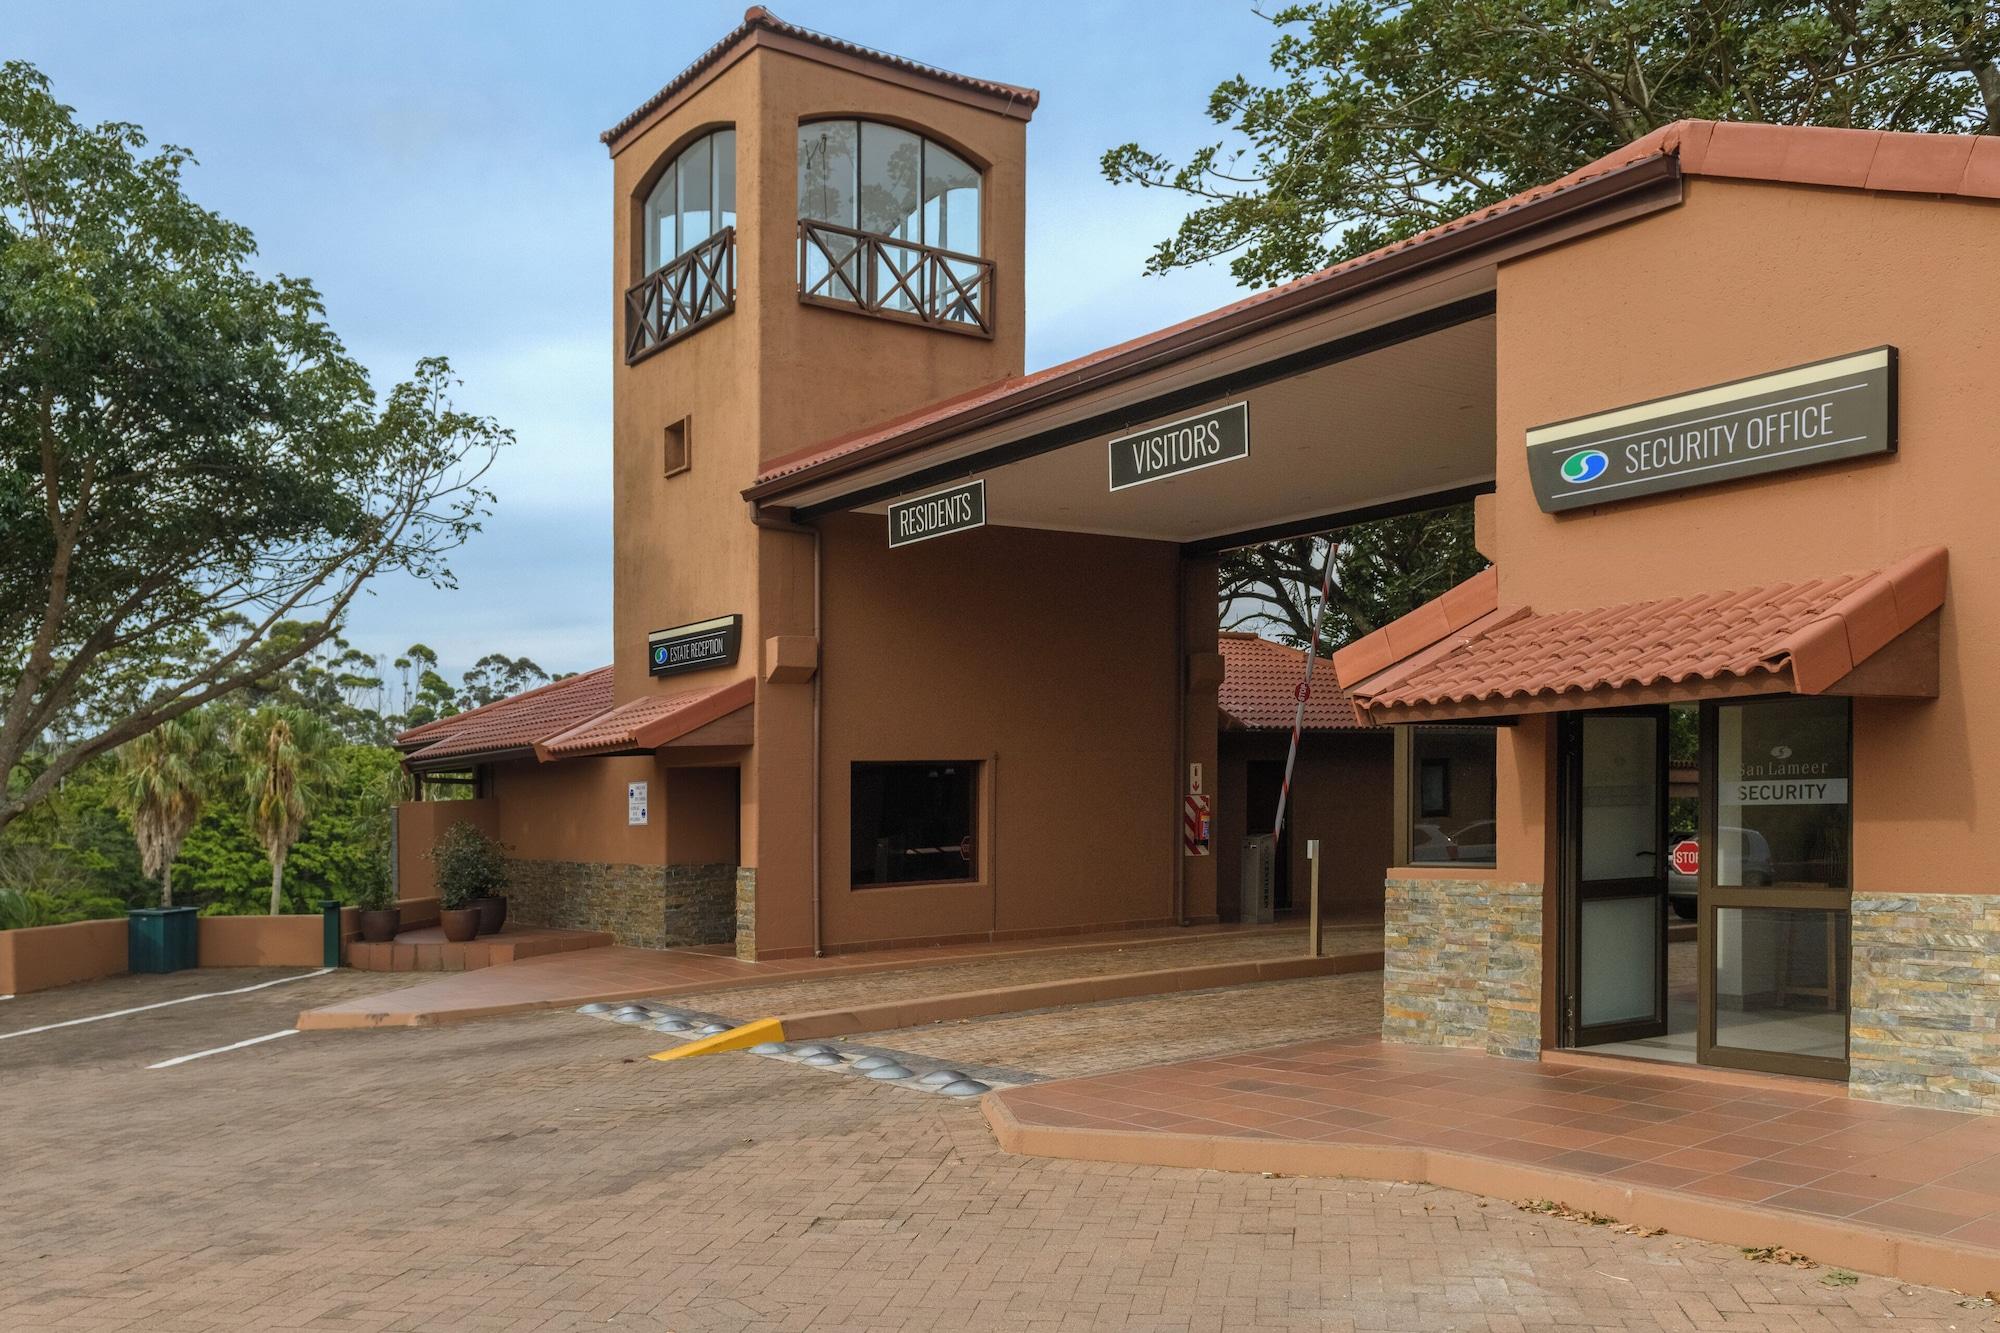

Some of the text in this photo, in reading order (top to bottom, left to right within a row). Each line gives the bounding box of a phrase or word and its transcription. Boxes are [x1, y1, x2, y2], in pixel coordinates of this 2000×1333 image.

[1132, 420, 1220, 474] VISITORS
[1625, 402, 1834, 474] SECURITY OFFICE
[899, 492, 971, 537] RESIDENTS
[670, 638, 724, 662] ESTATE RECEPTION
[1768, 761, 1828, 776] Lameer
[1738, 783, 1827, 801] SECURITY
